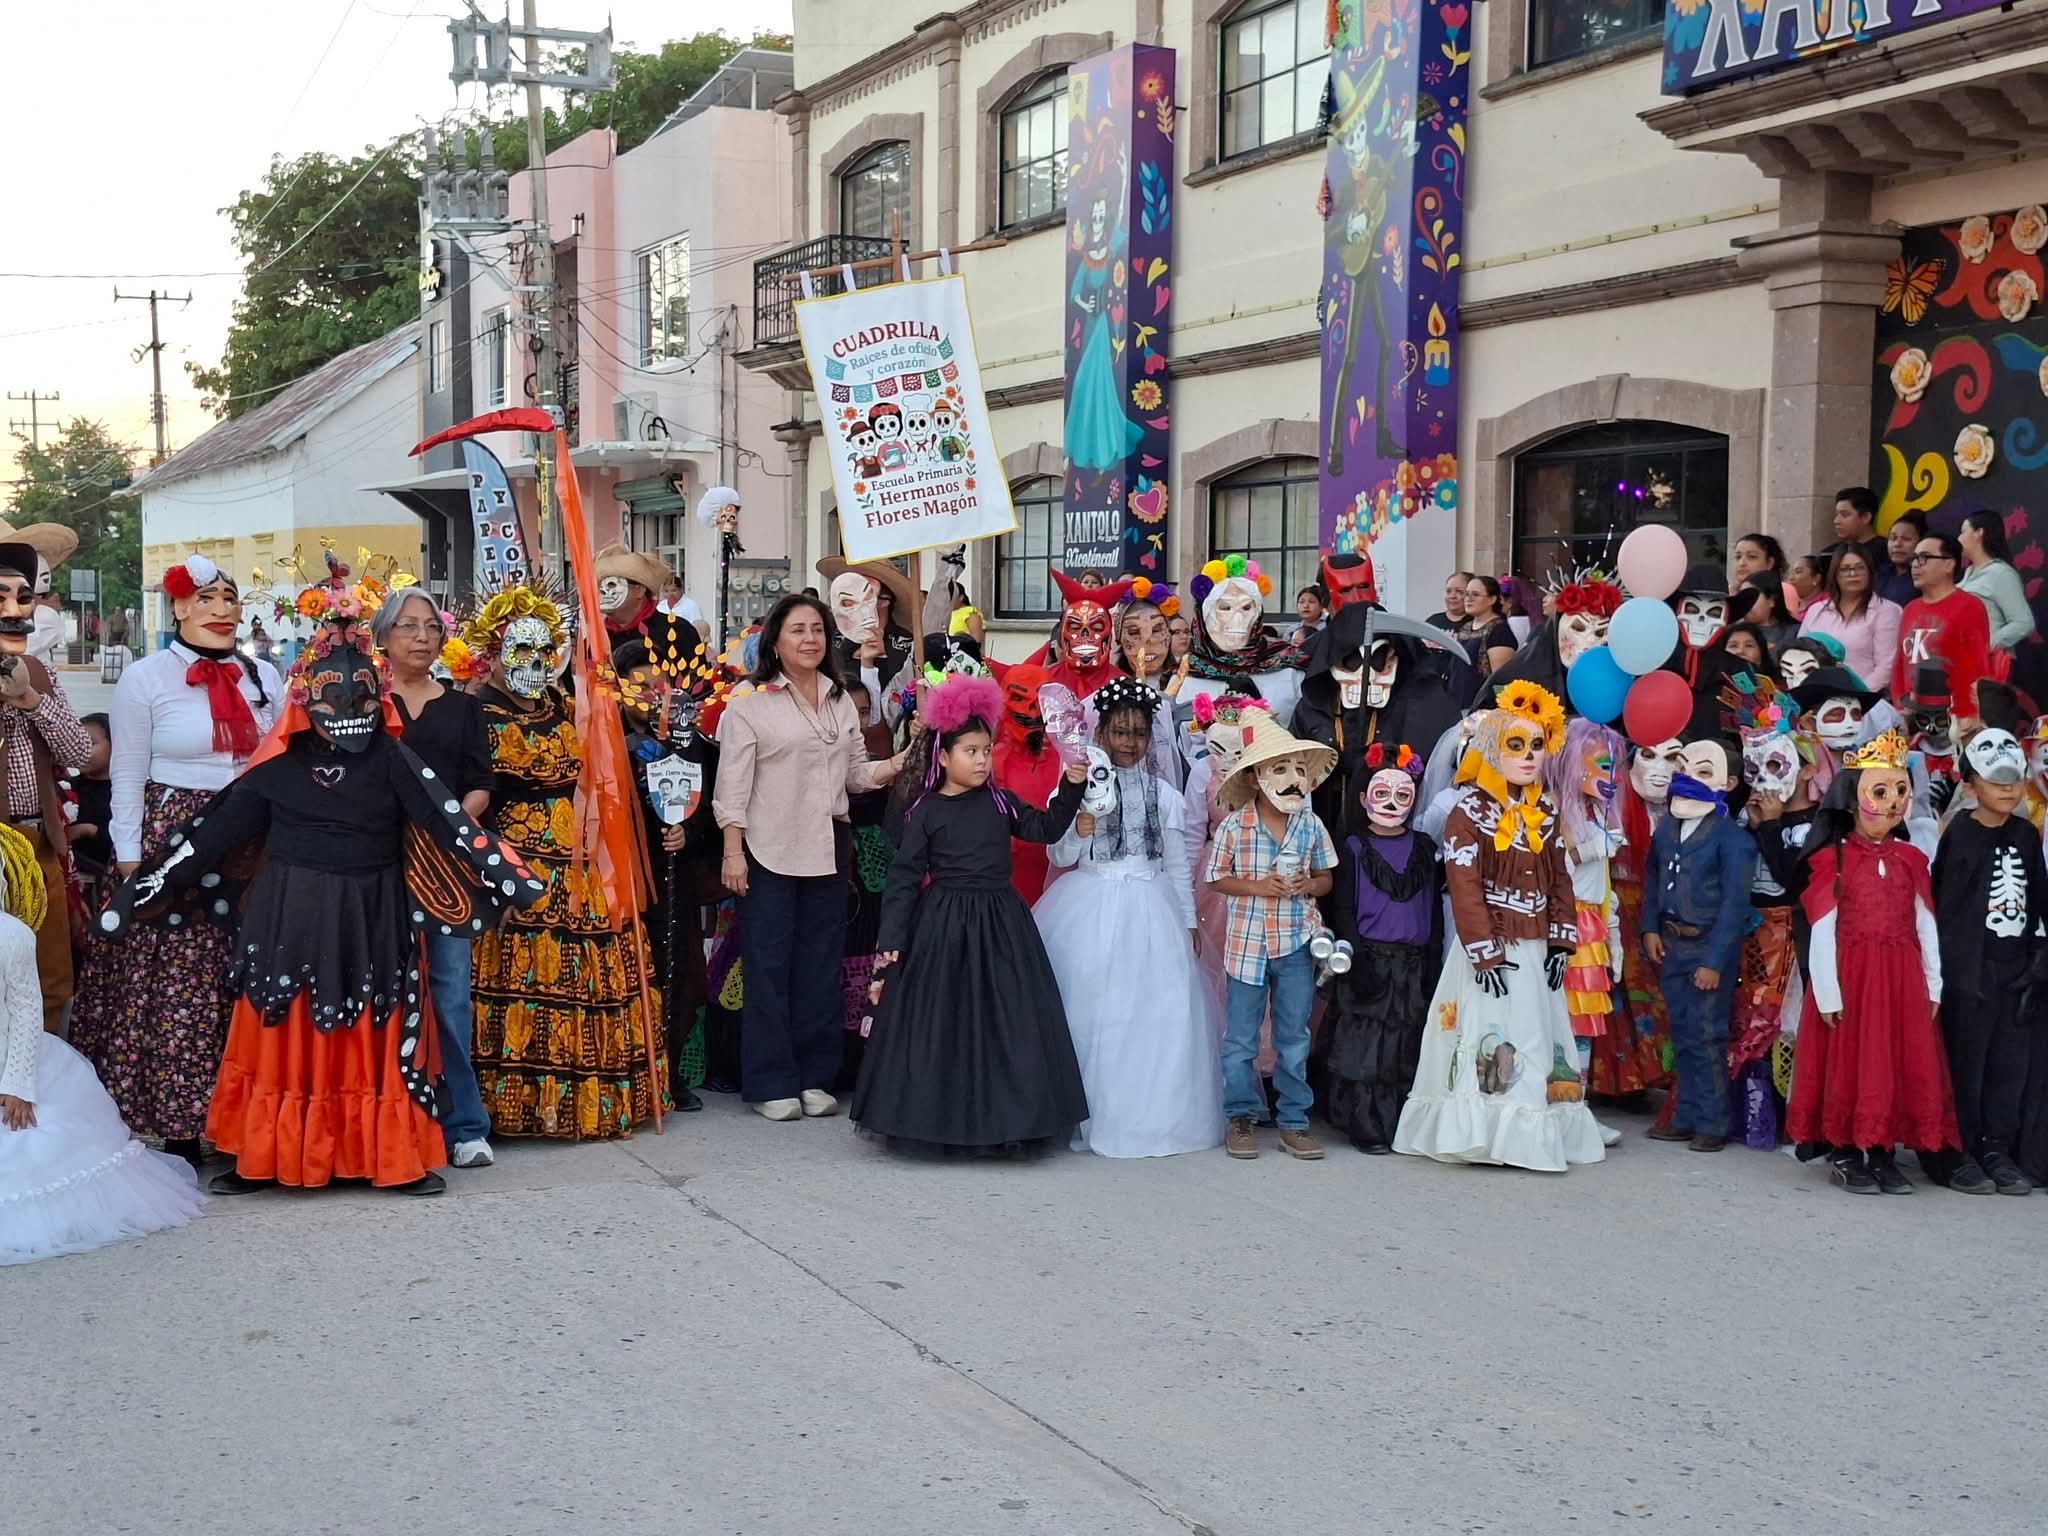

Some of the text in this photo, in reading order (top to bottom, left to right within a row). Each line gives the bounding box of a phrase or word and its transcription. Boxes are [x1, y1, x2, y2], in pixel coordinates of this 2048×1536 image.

[832, 321, 940, 358] CUADRILLA
[890, 343, 906, 356] de
[867, 357, 926, 380] y corazón
[871, 465, 963, 491] Escuela Primaria
[493, 490, 506, 504] Y
[879, 481, 960, 507] Hermanos
[864, 493, 978, 528] Flores Magón
[1065, 510, 1120, 543] XANTOLO
